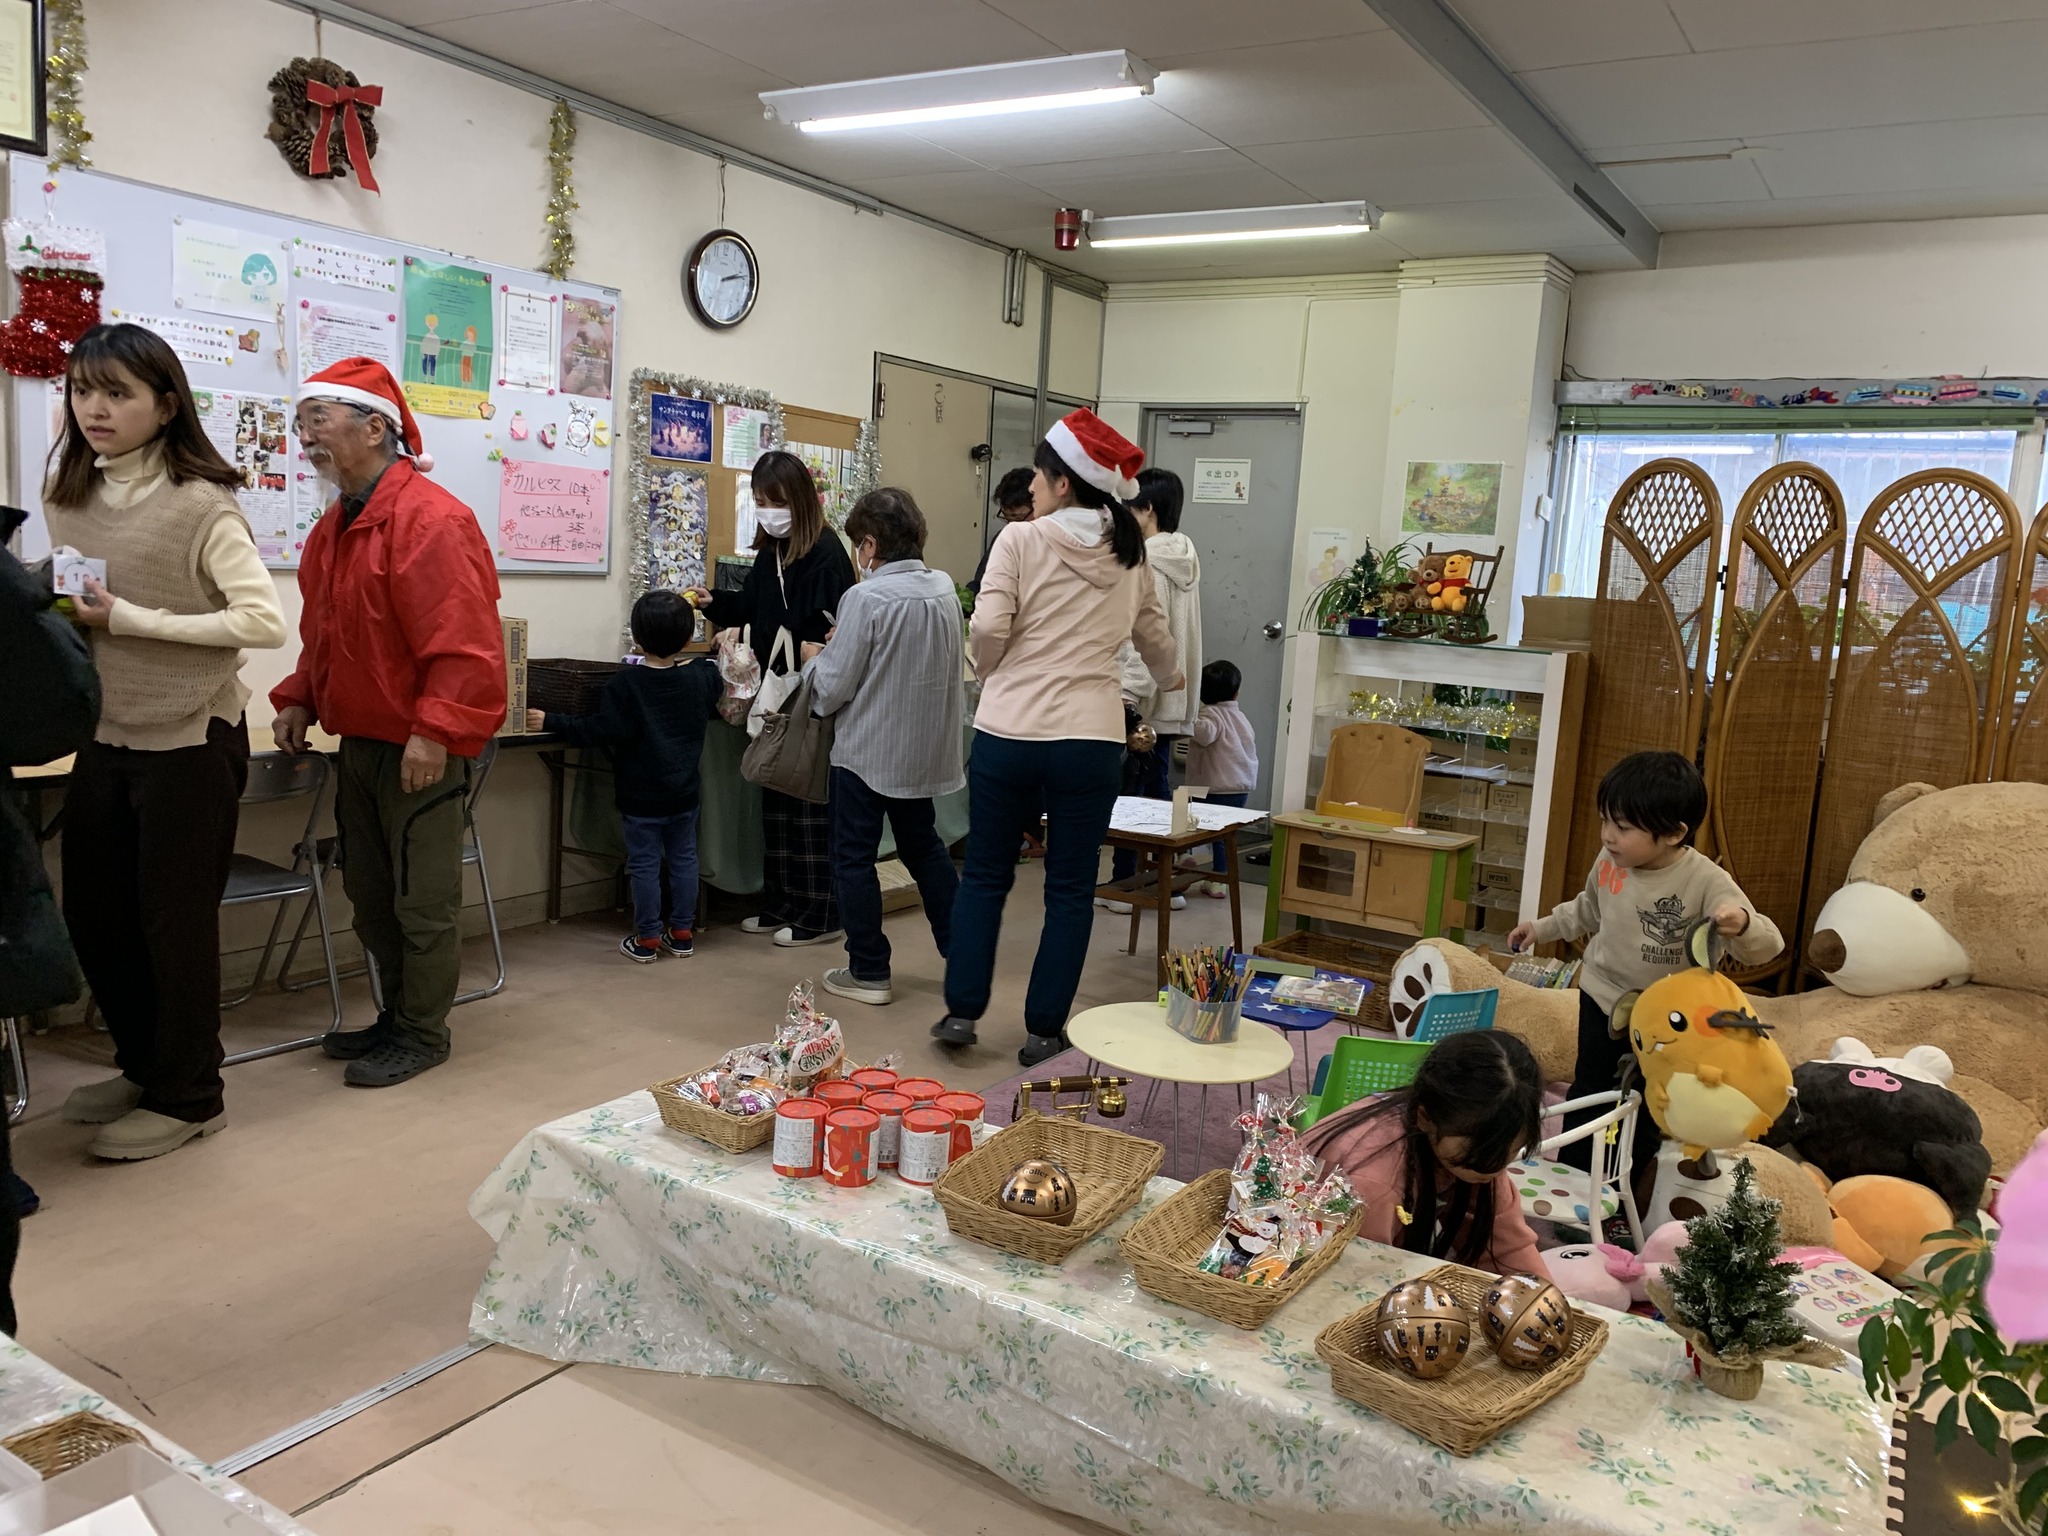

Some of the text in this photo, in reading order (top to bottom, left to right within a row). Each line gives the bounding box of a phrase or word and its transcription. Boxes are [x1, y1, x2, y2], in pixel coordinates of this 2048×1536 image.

[317, 257, 376, 276] おしらせ
[513, 474, 562, 492] カルピス
[1640, 944, 1684, 956] CHALLENGE
[1642, 953, 1681, 965] REQUIRED
